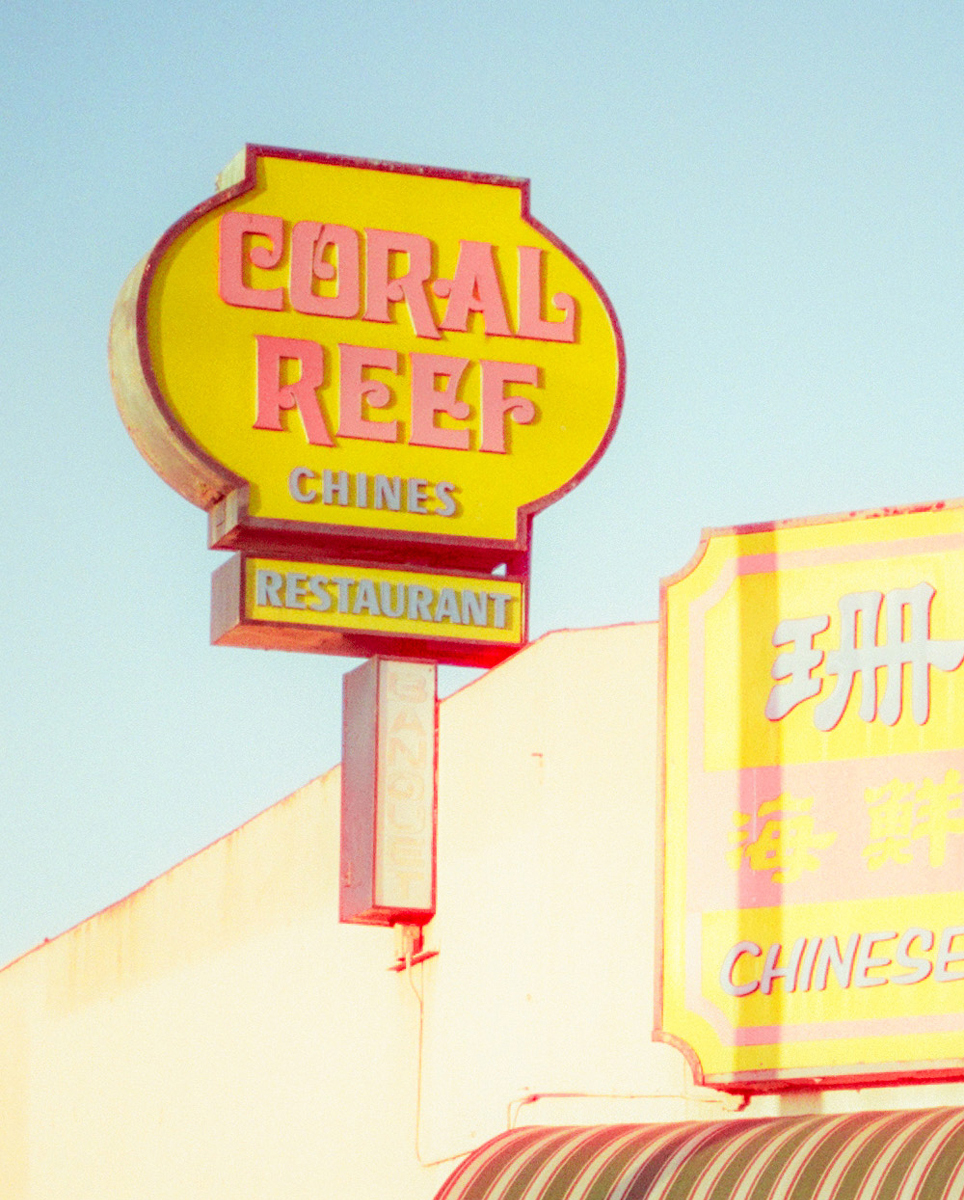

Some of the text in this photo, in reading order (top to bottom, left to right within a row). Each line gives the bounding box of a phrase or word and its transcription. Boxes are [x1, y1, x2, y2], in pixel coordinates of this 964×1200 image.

[219, 211, 577, 343] CORAL
[252, 334, 538, 455] REEF
[288, 466, 460, 518] CHINES
[256, 569, 513, 630] RESTAURANT
